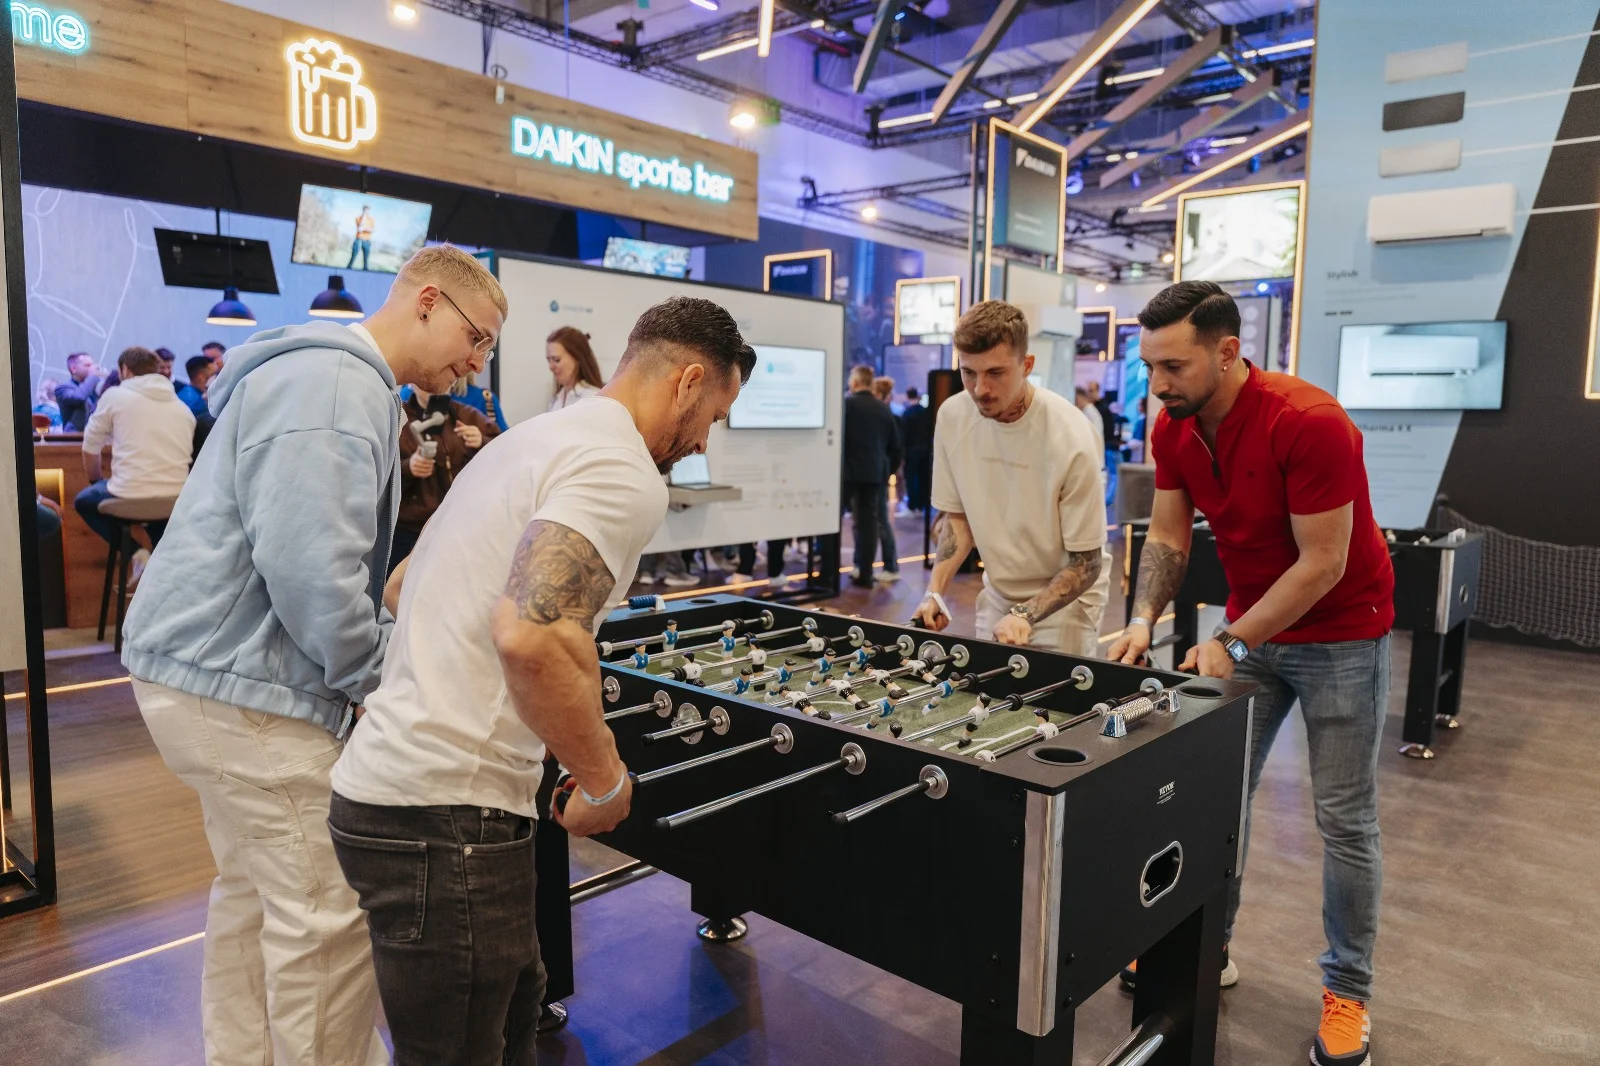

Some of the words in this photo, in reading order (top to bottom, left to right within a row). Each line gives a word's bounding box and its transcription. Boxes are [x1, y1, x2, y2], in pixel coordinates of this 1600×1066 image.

[513, 116, 614, 175] DAIKIN
[617, 151, 692, 193] sports
[694, 162, 734, 202] bar
